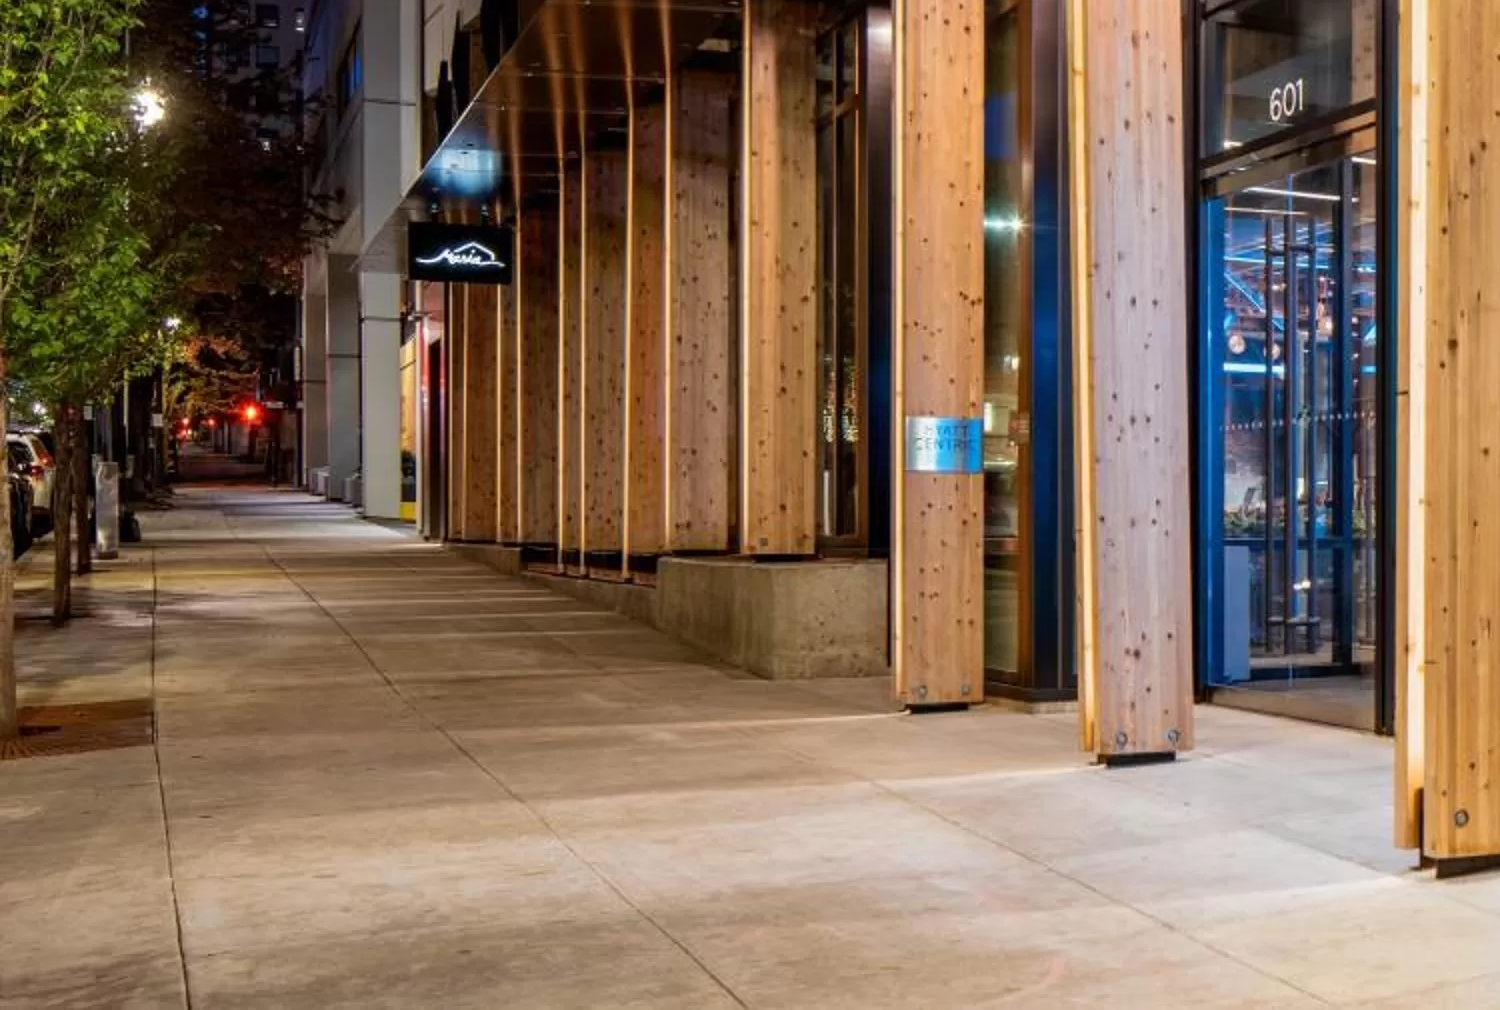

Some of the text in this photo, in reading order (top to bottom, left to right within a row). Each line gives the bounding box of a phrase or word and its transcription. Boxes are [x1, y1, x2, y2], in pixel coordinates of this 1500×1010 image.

[1269, 78, 1304, 121] 601
[925, 424, 969, 438] HYATT
[913, 437, 978, 451] CENTRIC
